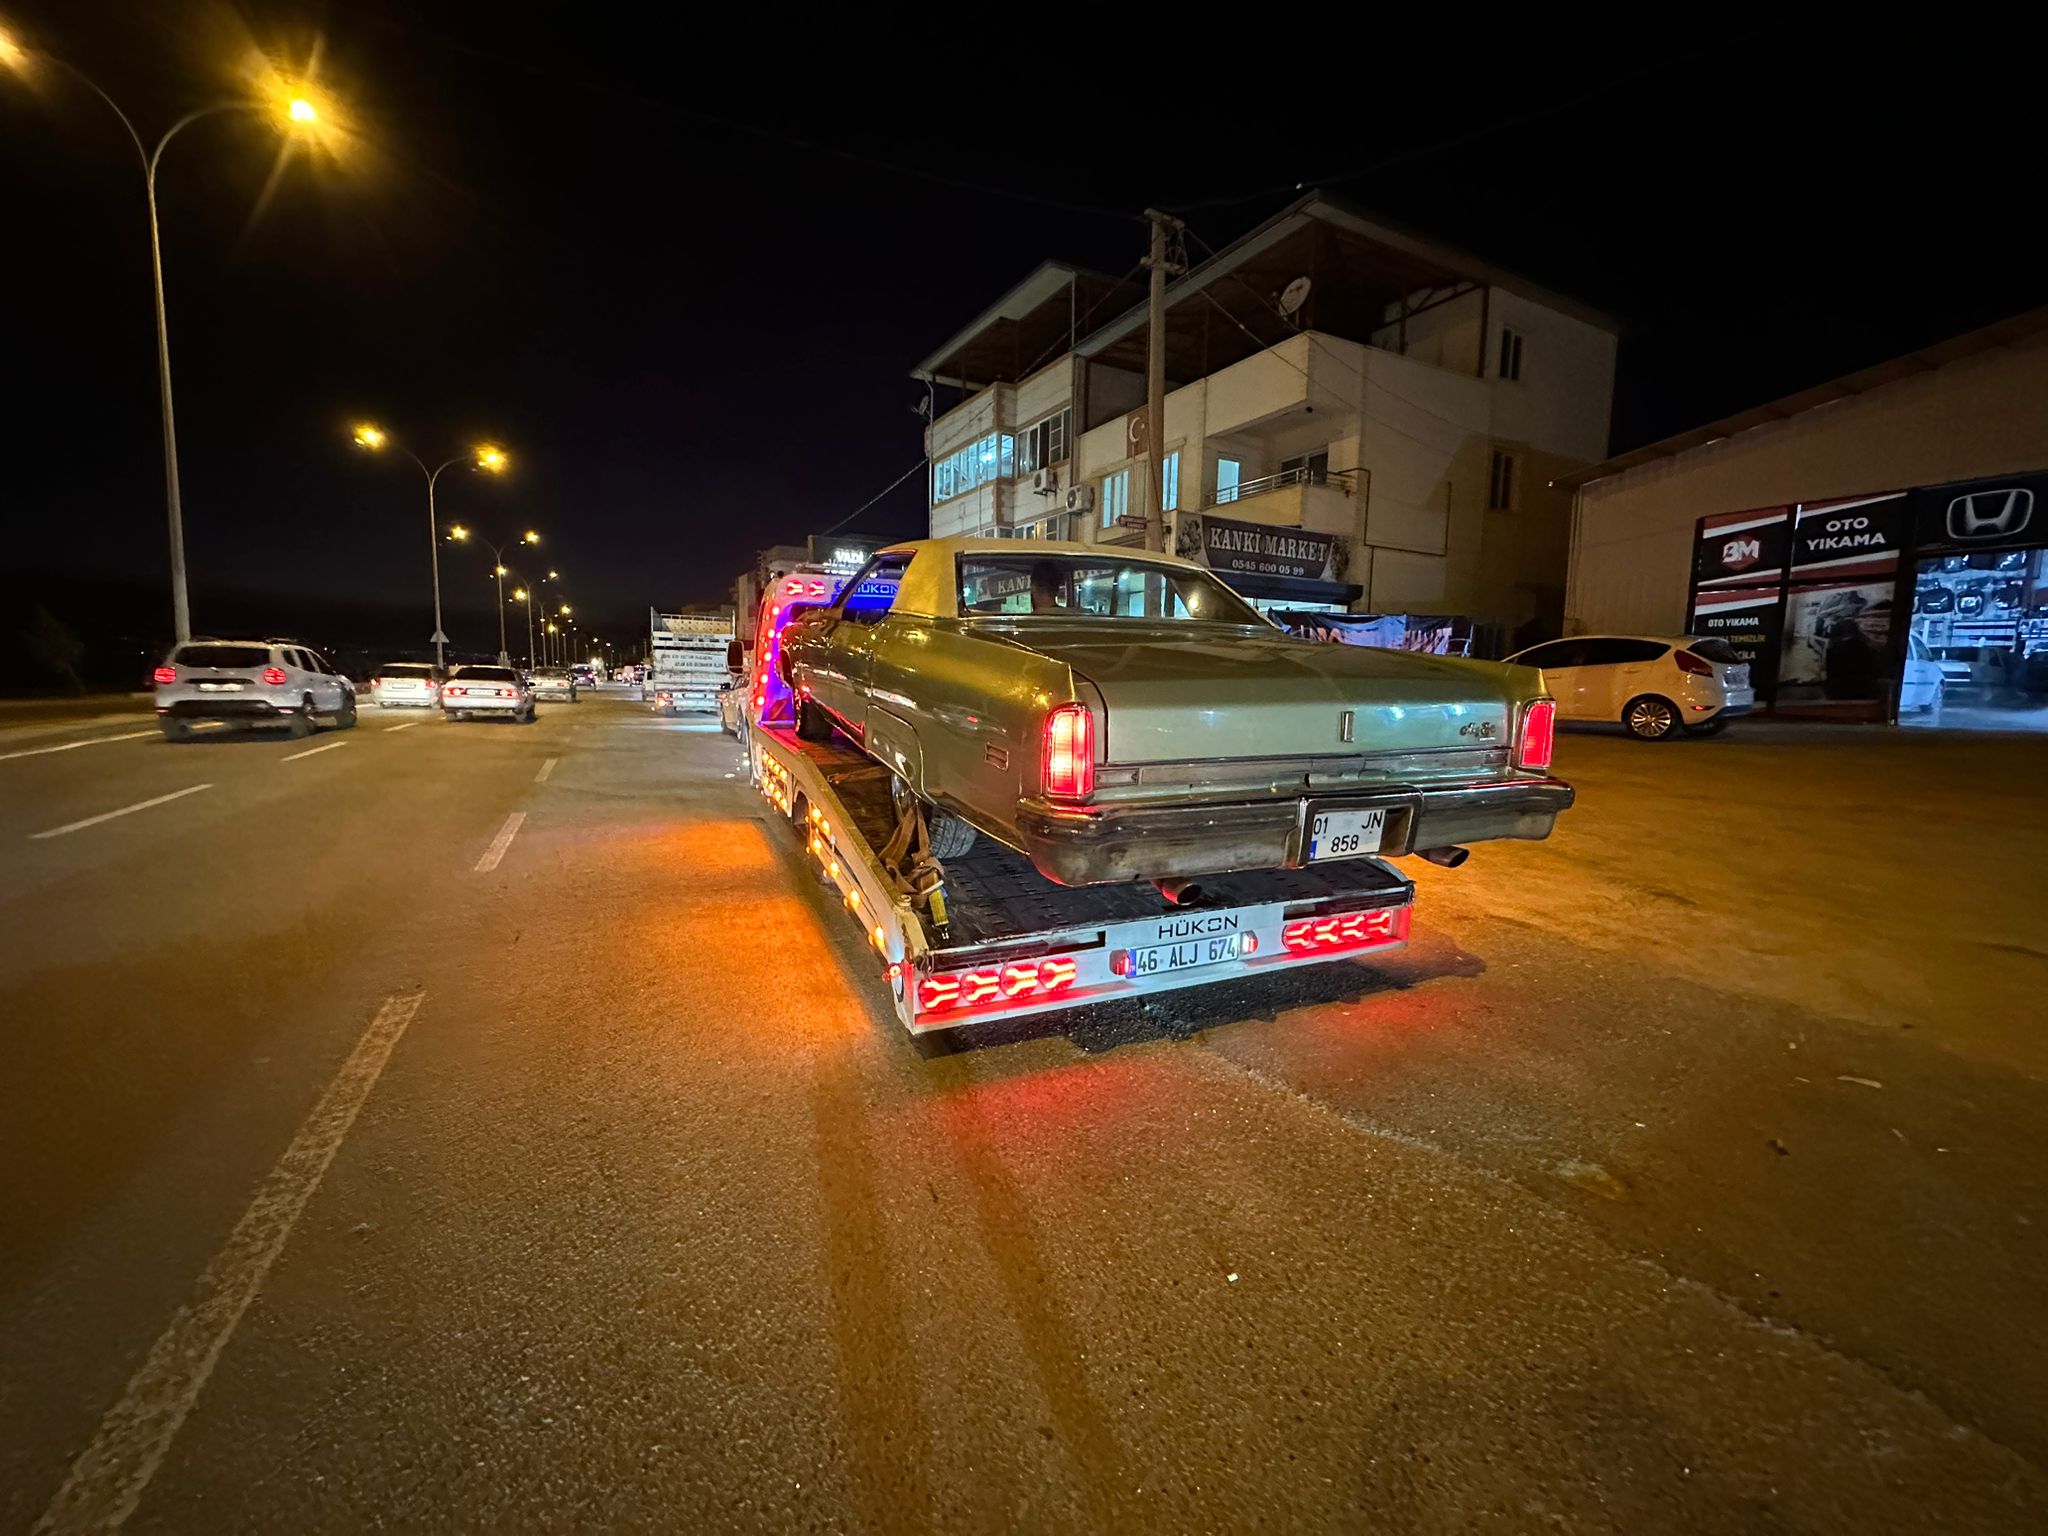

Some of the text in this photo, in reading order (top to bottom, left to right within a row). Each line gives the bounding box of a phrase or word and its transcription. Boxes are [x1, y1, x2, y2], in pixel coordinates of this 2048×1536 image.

[1825, 517, 1869, 533] OTO
[1209, 528, 1328, 562] KANKİ MARKET
[1806, 532, 1887, 551] YIKAMA
[1232, 559, 1305, 577] 0545 600 05 99
[1707, 617, 1760, 628] OTO YIKAMA
[1313, 811, 1383, 835] 01 JN
[1331, 834, 1359, 853] 858
[1158, 915, 1238, 939] HÜKON
[1138, 937, 1236, 972] 46 ALJ 674
